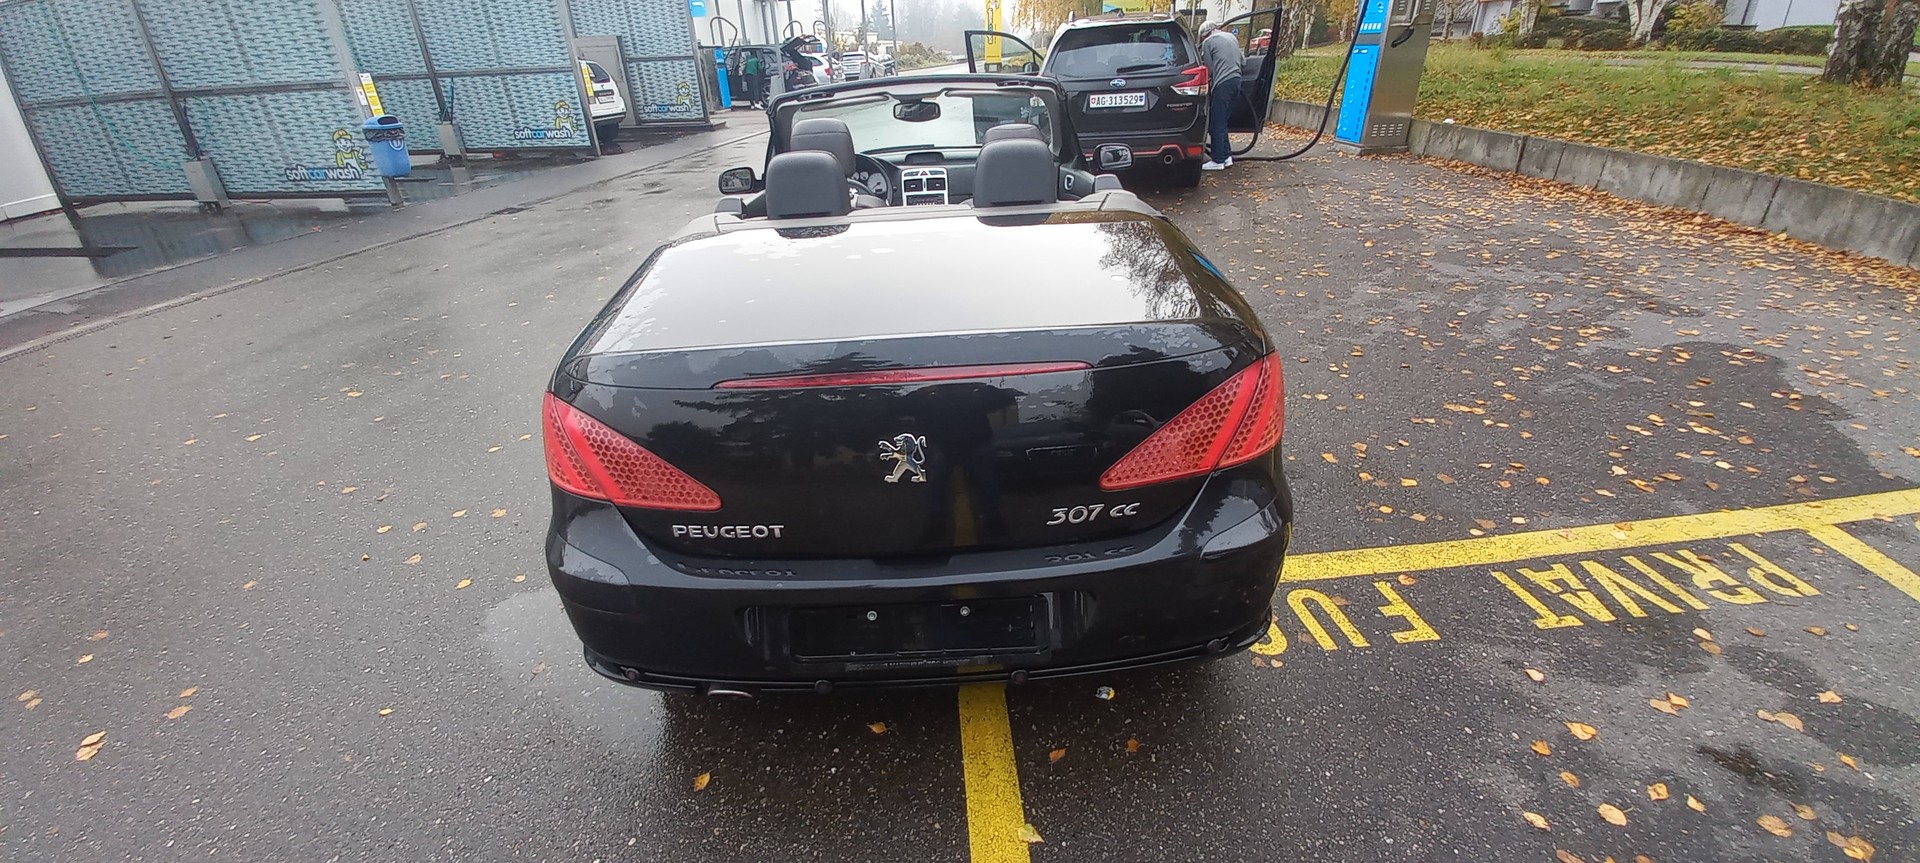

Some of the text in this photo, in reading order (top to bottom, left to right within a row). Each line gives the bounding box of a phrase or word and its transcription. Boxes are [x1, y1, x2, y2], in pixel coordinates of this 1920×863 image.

[644, 103, 690, 112] softcarwash
[514, 127, 572, 139] softcarwash
[286, 165, 360, 180] softcarwash
[1046, 503, 1105, 525] 307
[671, 524, 785, 538] PEUGEOT
[1490, 543, 1821, 630] PRIVAT
